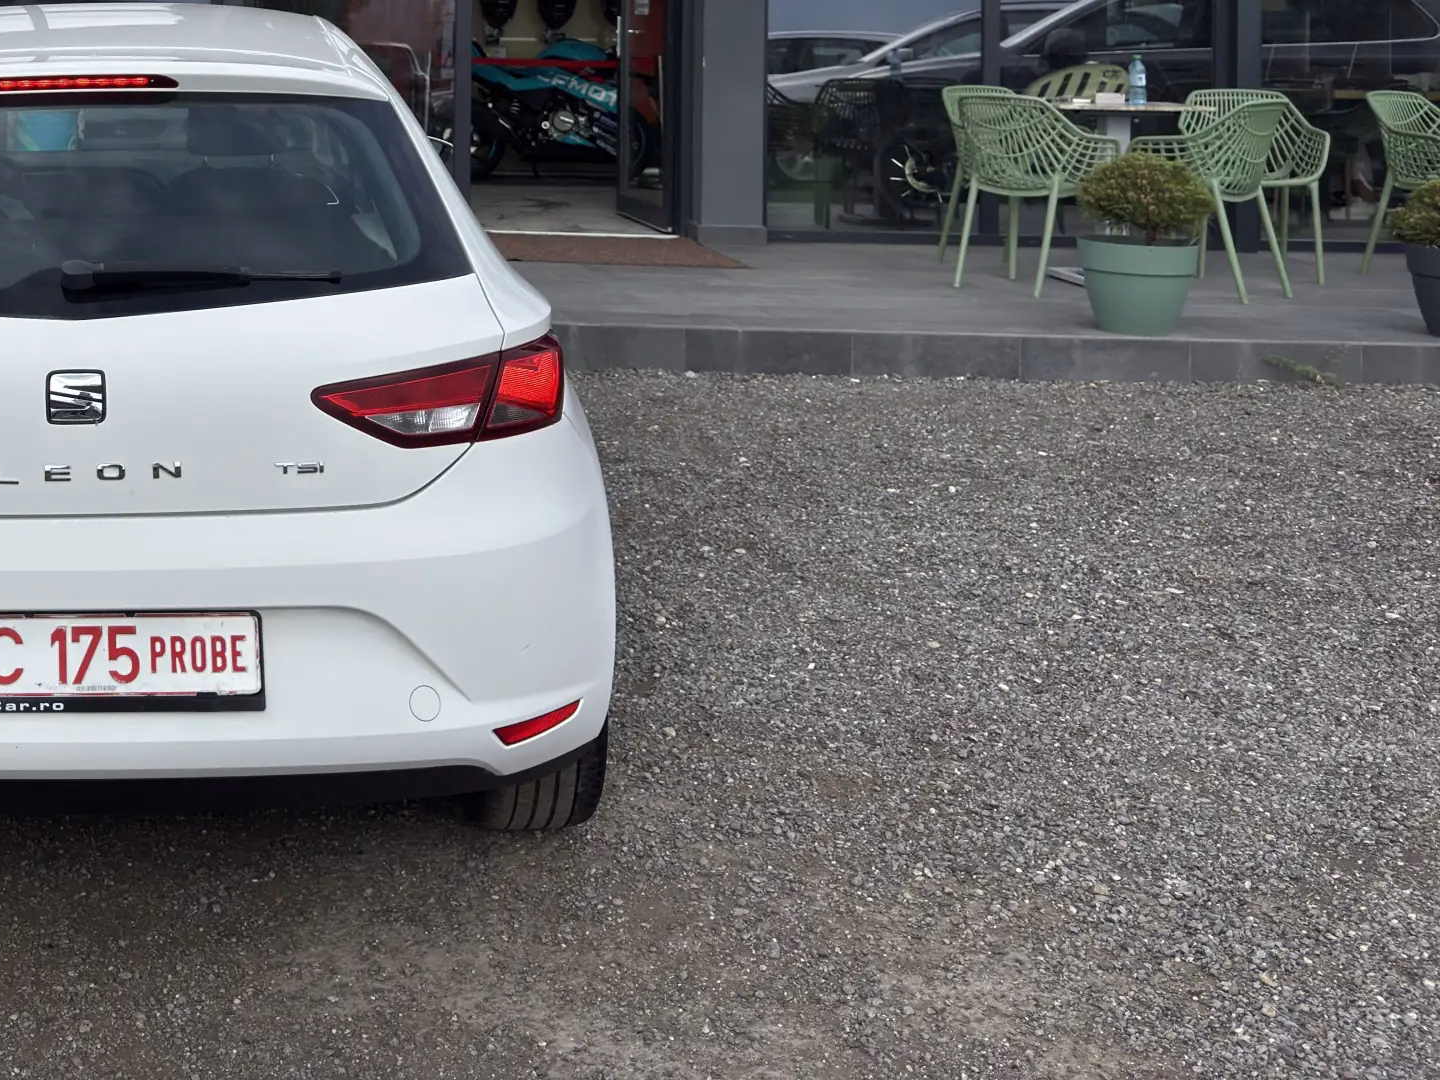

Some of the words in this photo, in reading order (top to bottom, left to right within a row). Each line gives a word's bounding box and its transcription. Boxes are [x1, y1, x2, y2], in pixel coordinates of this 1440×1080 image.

[274, 461, 325, 475] TSI
[50, 625, 141, 685] 175
[149, 634, 247, 674] PROBE
